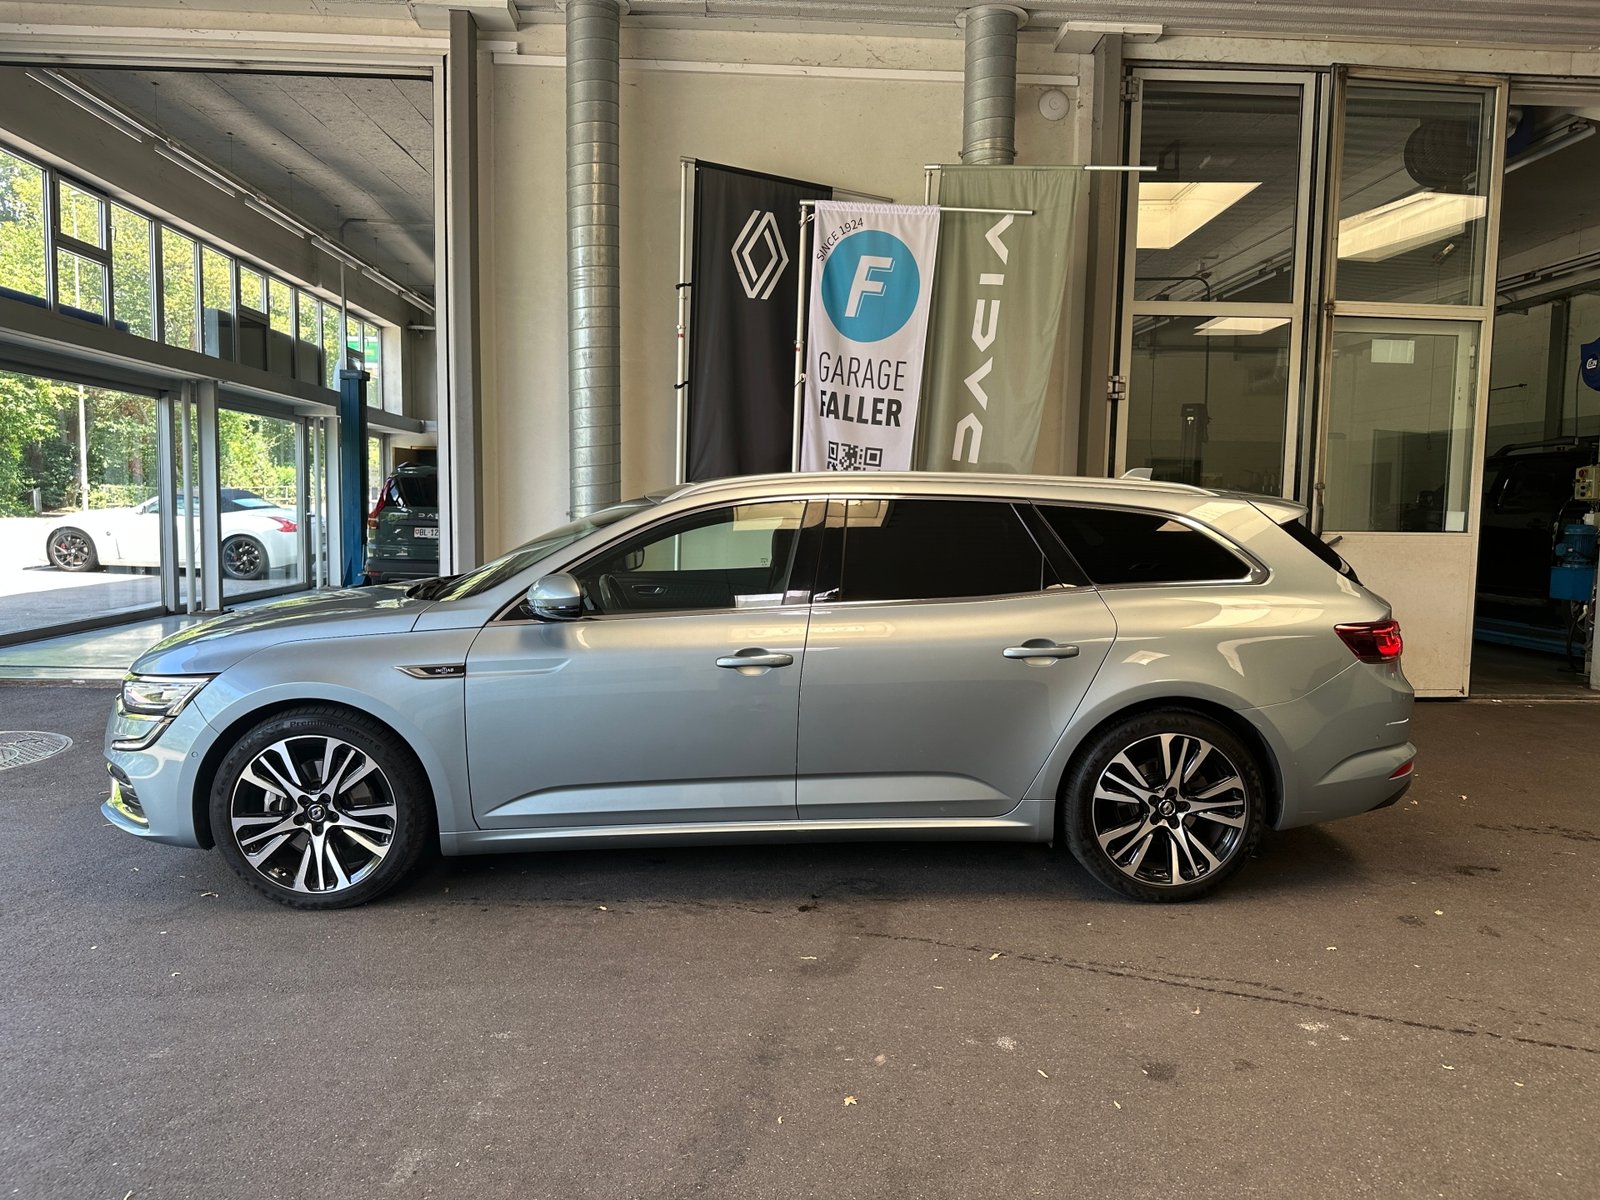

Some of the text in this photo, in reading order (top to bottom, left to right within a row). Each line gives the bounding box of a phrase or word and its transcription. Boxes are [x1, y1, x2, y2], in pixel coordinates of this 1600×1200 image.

[816, 217, 865, 262] SINCE 1924
[844, 255, 895, 317] F
[819, 351, 907, 392] GARAGE
[819, 389, 903, 428] FALLER
[289, 719, 375, 746] PremiumContact
